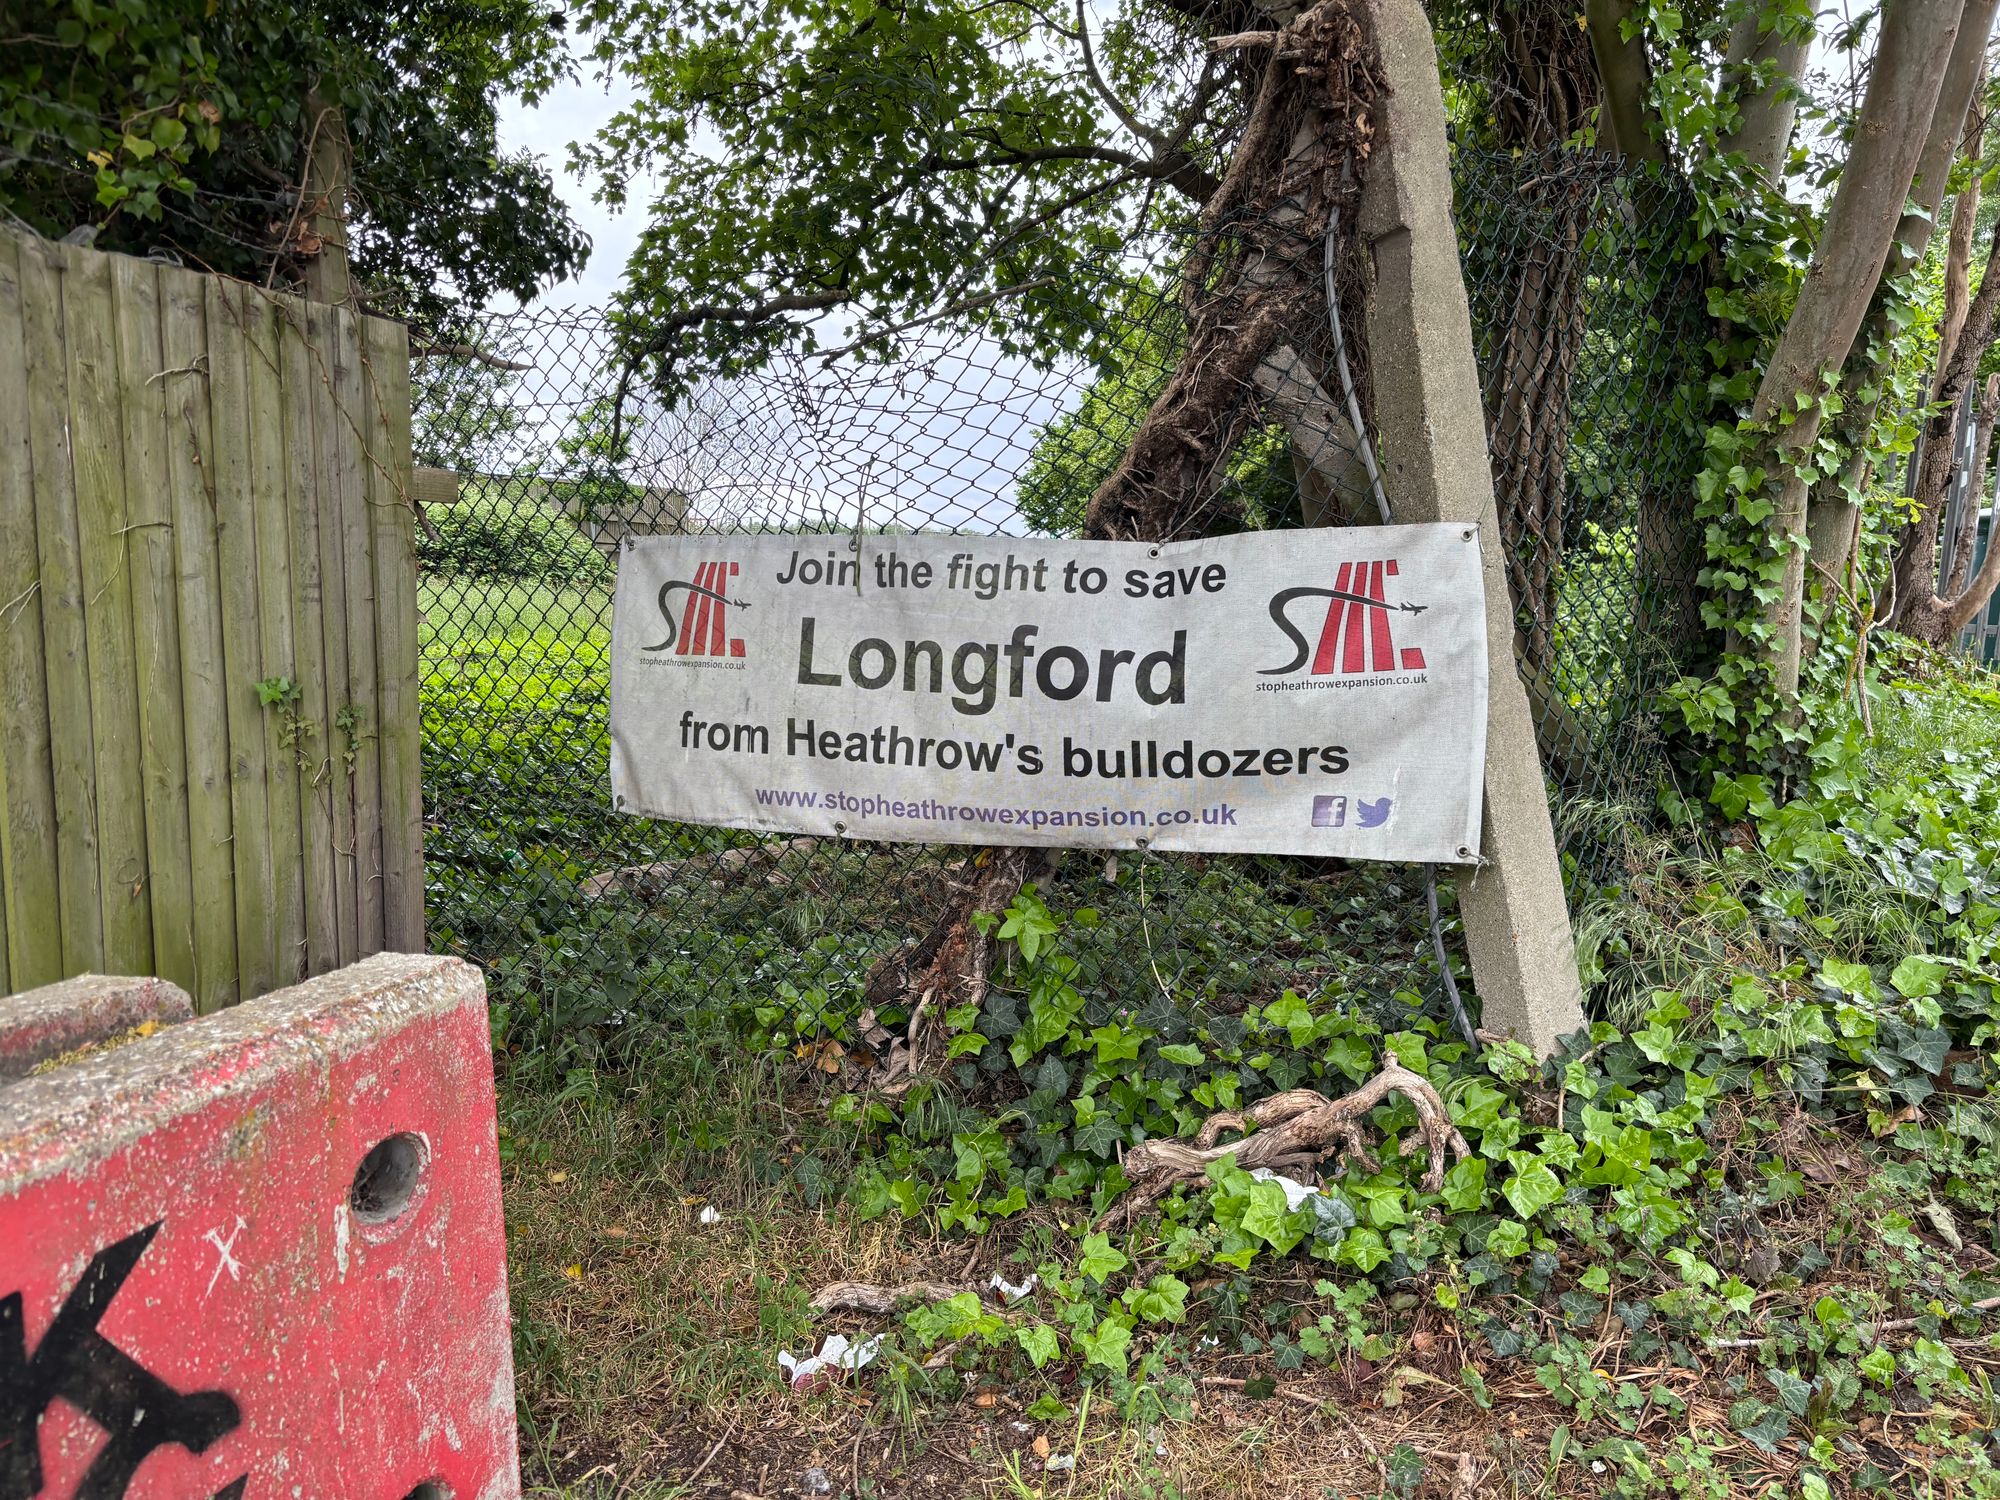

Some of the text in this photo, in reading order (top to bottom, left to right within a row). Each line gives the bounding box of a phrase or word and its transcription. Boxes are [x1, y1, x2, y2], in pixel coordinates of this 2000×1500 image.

[776, 550, 1227, 600] Join the fight to save
[639, 656, 746, 671] stopheathrowexpansion.co.uk
[798, 616, 1188, 715] Longford
[1255, 673, 1428, 694] stopheathrowexpansion.co.uk
[679, 711, 1350, 779] from Heathrow's bulldozers
[755, 788, 1237, 830] www.stopheathrowexpansion.co.uk
